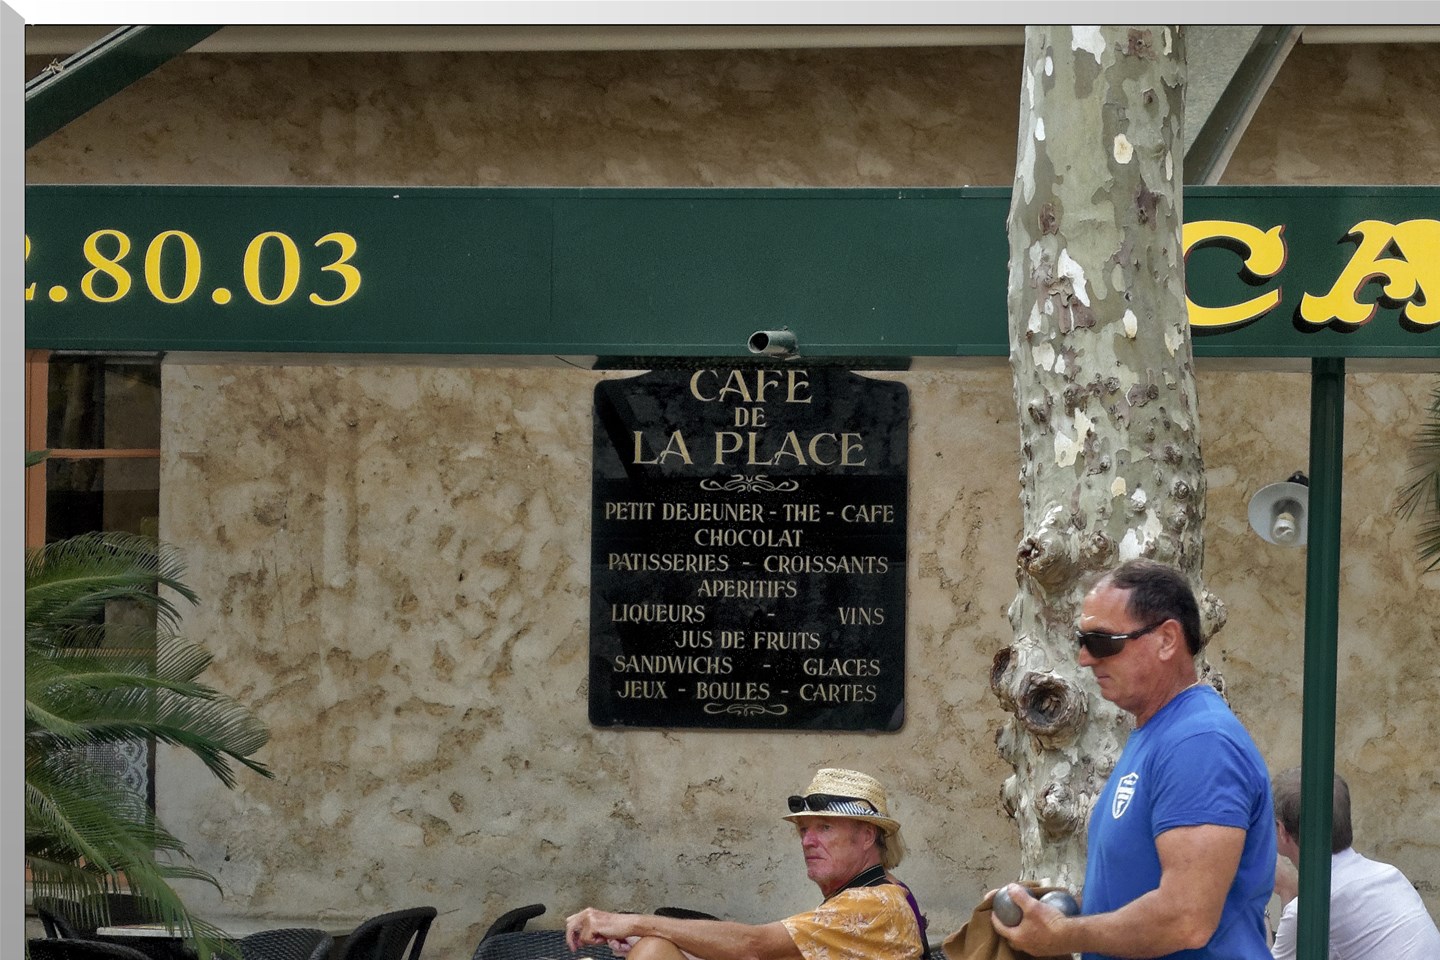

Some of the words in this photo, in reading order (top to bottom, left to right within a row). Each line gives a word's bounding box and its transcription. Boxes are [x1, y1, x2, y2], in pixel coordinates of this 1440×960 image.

[25, 228, 362, 306] .80.03
[689, 369, 812, 404] CAFE
[734, 407, 767, 428] DE
[632, 429, 694, 465] LA
[713, 430, 867, 467] PLACE
[605, 502, 656, 520] PETIT
[662, 502, 764, 523] DEJEUNER
[782, 504, 820, 522] THE
[841, 504, 894, 523] CAFE
[694, 528, 804, 547] CHOCOLAT
[608, 553, 729, 574] PATISSERIES
[763, 555, 889, 575] CROISSANTS
[697, 579, 798, 600] APERITIFS
[611, 603, 706, 624] LIQUEURS
[838, 607, 885, 626] VINS
[674, 630, 714, 649] JUS
[720, 631, 745, 649] DE
[753, 631, 822, 651] FRUITS
[612, 655, 733, 674] SANDWICHS
[802, 658, 881, 677] GLACES
[616, 680, 668, 699] JEUX
[696, 681, 770, 700] BOULES
[799, 683, 877, 703] CARTES
